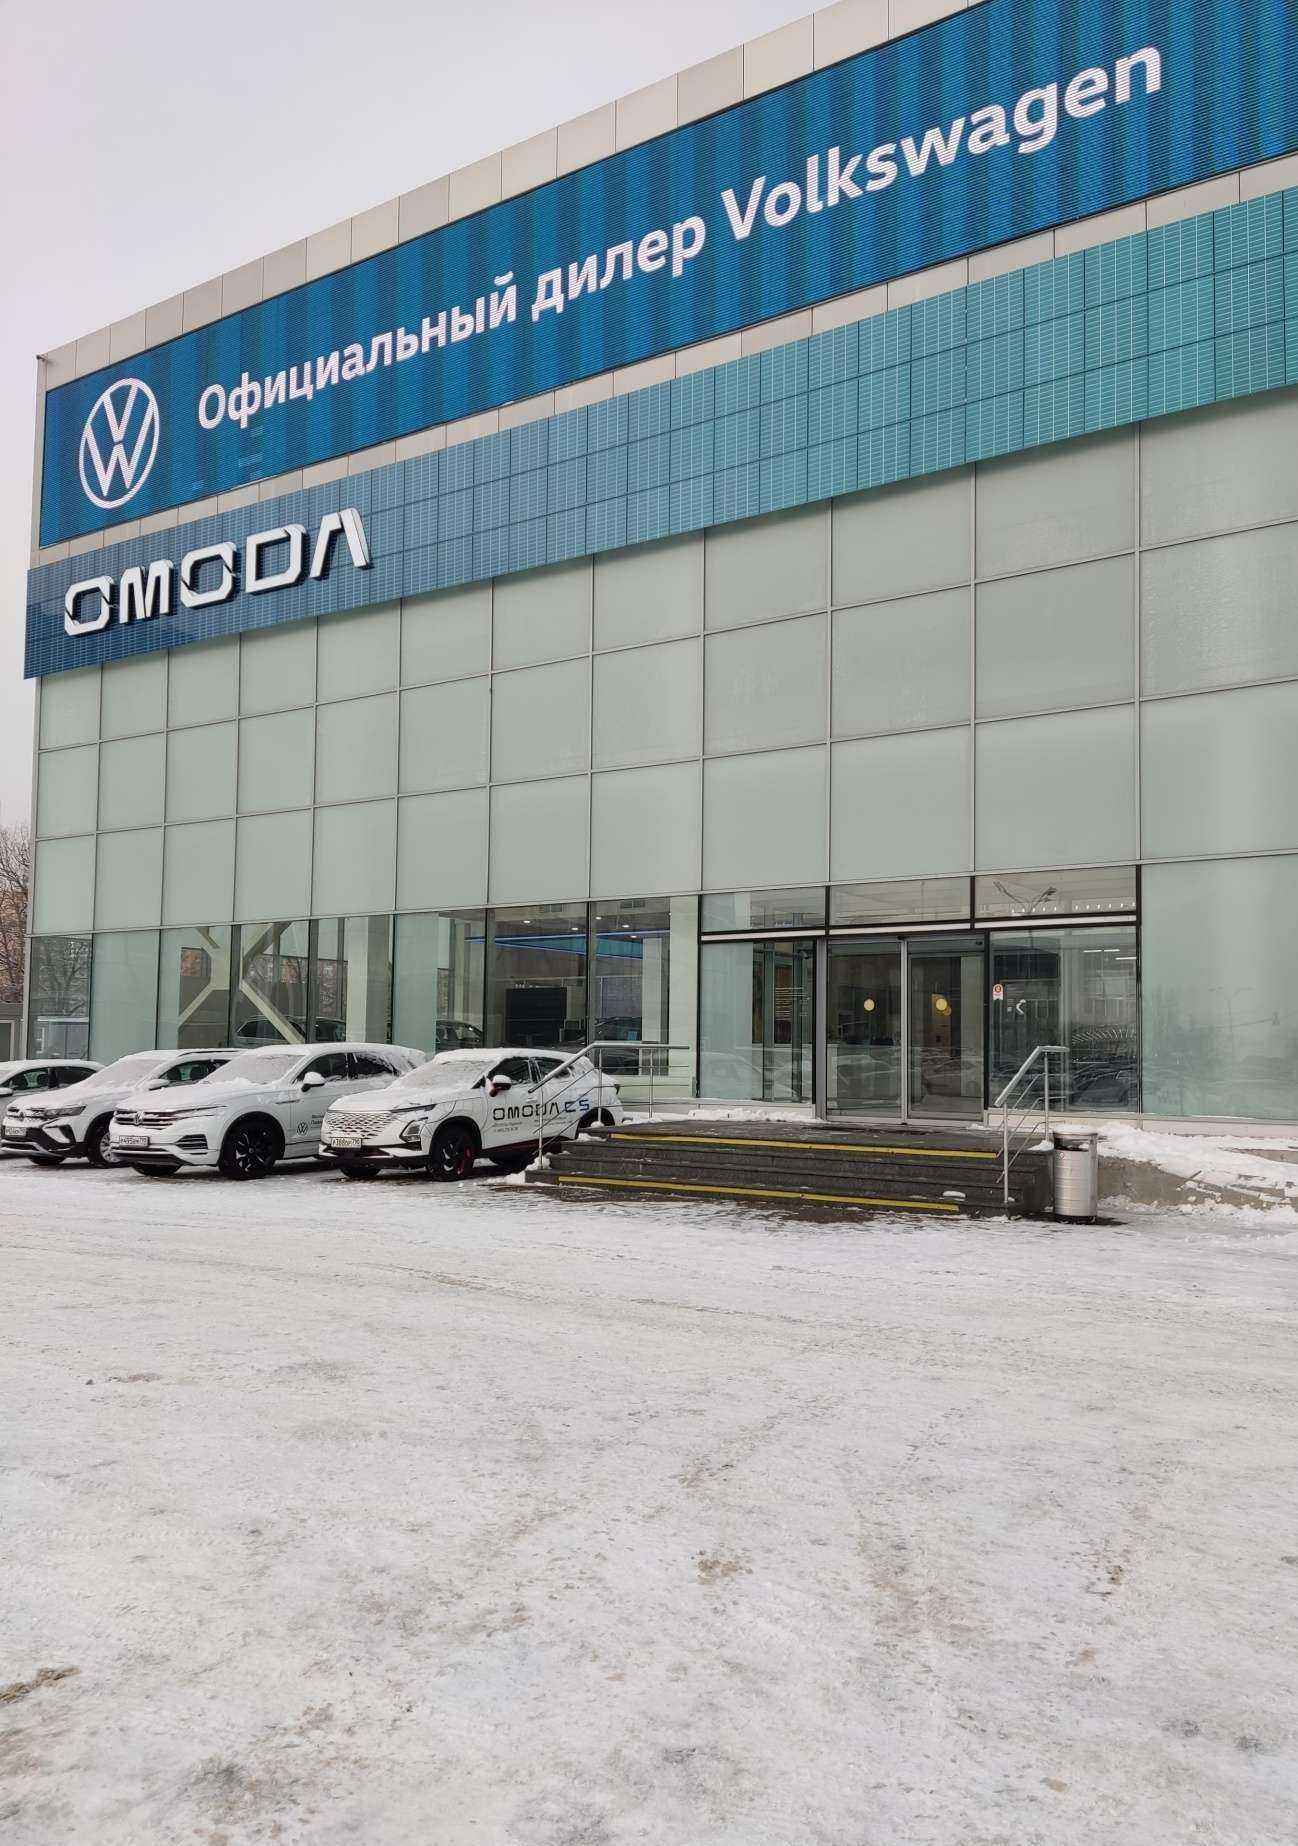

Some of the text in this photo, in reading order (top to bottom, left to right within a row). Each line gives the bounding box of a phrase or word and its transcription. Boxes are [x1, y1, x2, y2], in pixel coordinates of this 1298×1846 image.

[197, 47, 1162, 431] Официальный дилер Volkswagen
[78, 378, 160, 510] VW
[64, 507, 370, 637] OMODA
[493, 1102, 559, 1120] OMODA
